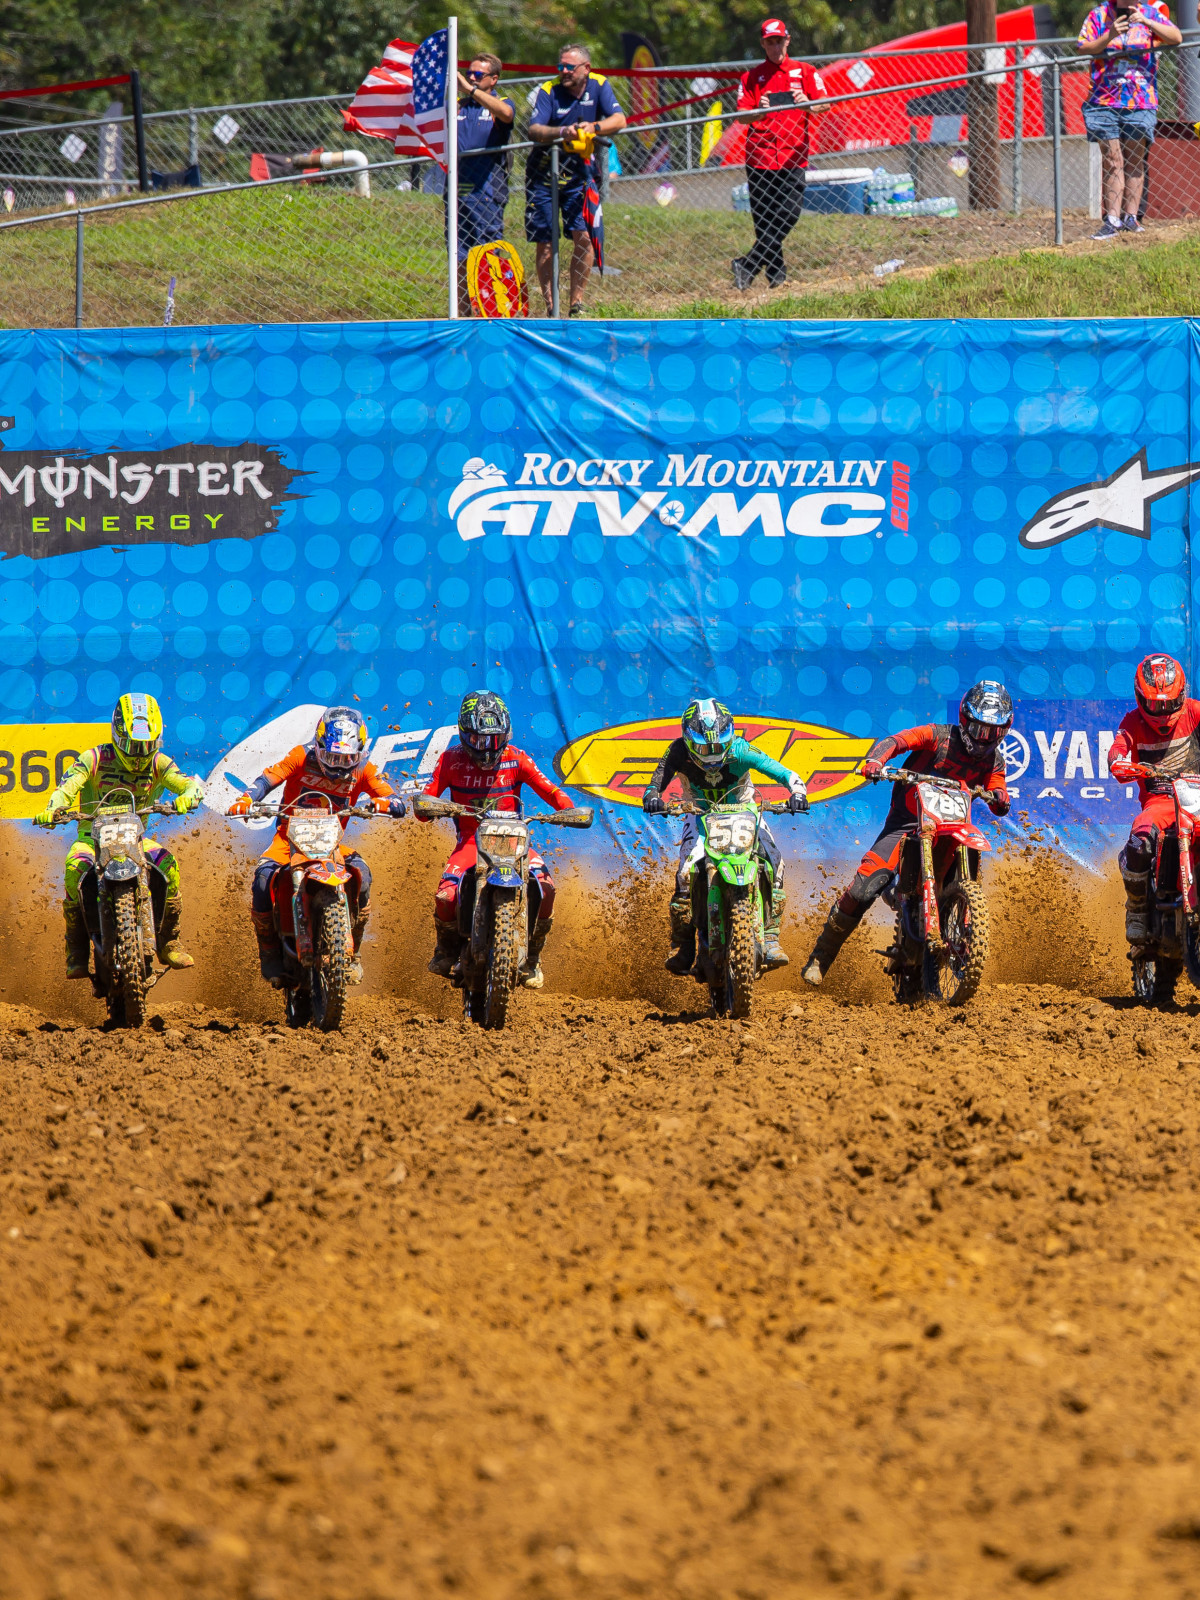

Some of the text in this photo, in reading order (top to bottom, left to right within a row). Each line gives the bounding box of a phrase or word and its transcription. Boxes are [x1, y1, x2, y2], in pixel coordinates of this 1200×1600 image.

[0, 456, 273, 508] MONSTER
[514, 452, 886, 487] ROCKY MOUNTAIN
[32, 513, 223, 533] ENERGY
[709, 820, 755, 849] 56
